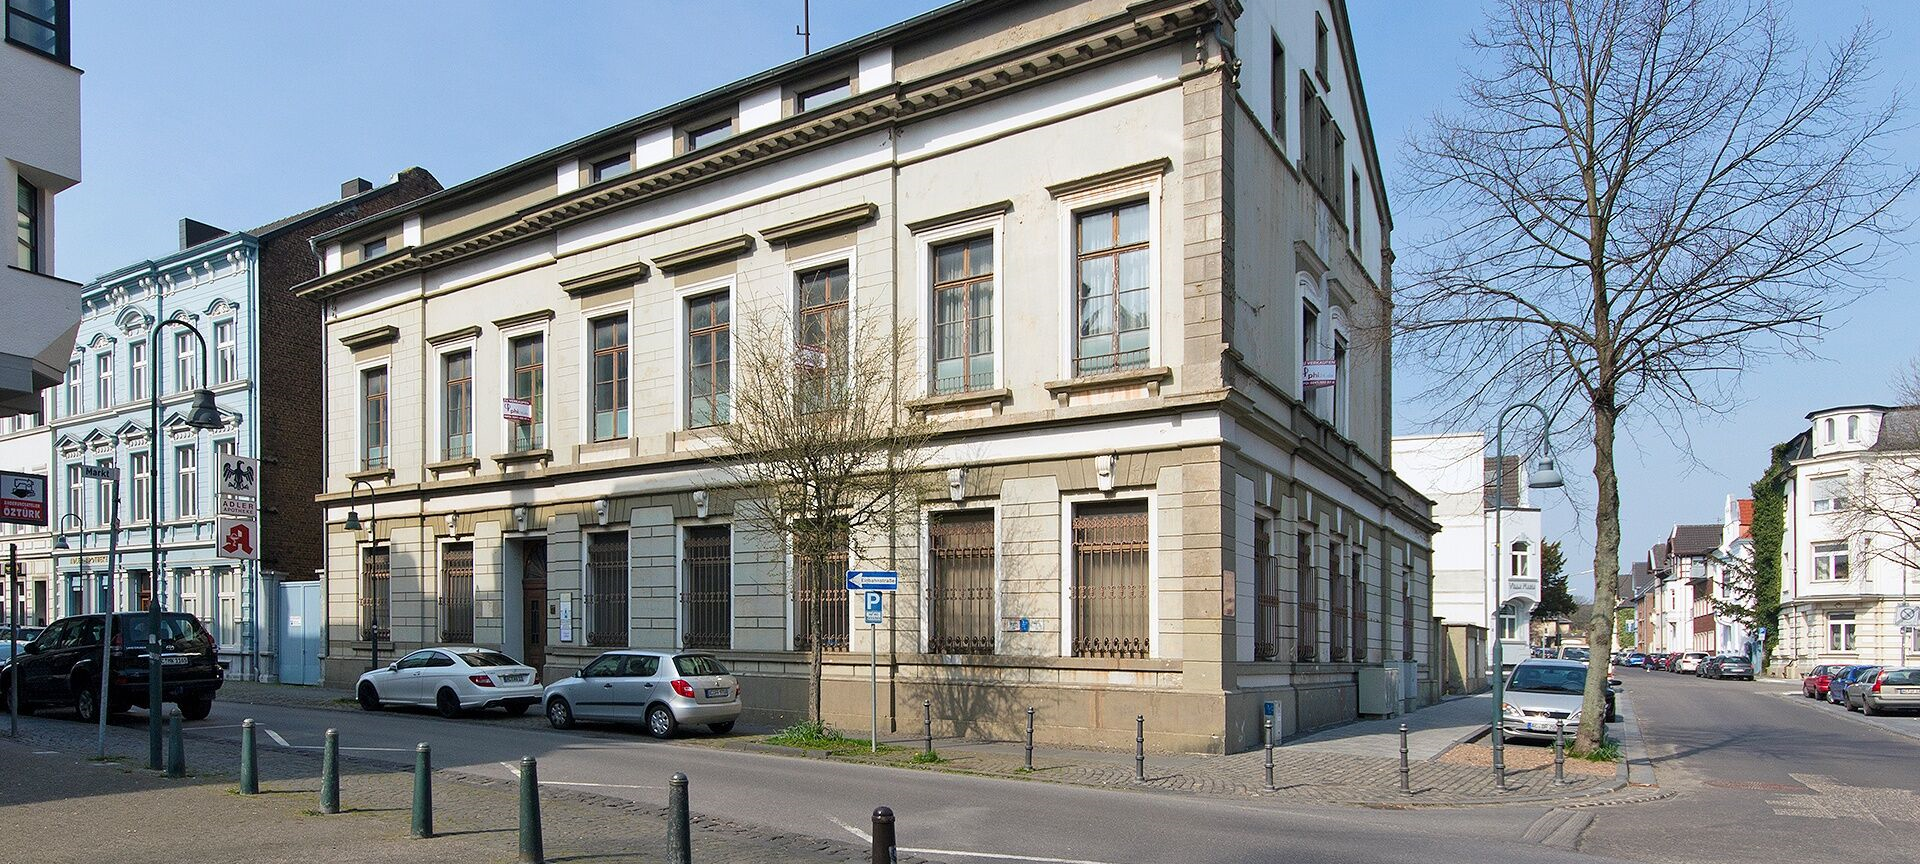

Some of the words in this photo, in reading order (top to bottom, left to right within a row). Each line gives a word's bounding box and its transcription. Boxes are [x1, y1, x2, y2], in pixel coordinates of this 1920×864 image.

[85, 467, 110, 478] Markt
[222, 500, 254, 510] ADLER
[3, 506, 41, 519] ÖZTÜRK
[223, 507, 254, 515] APOTHEKE
[867, 593, 880, 610] P
